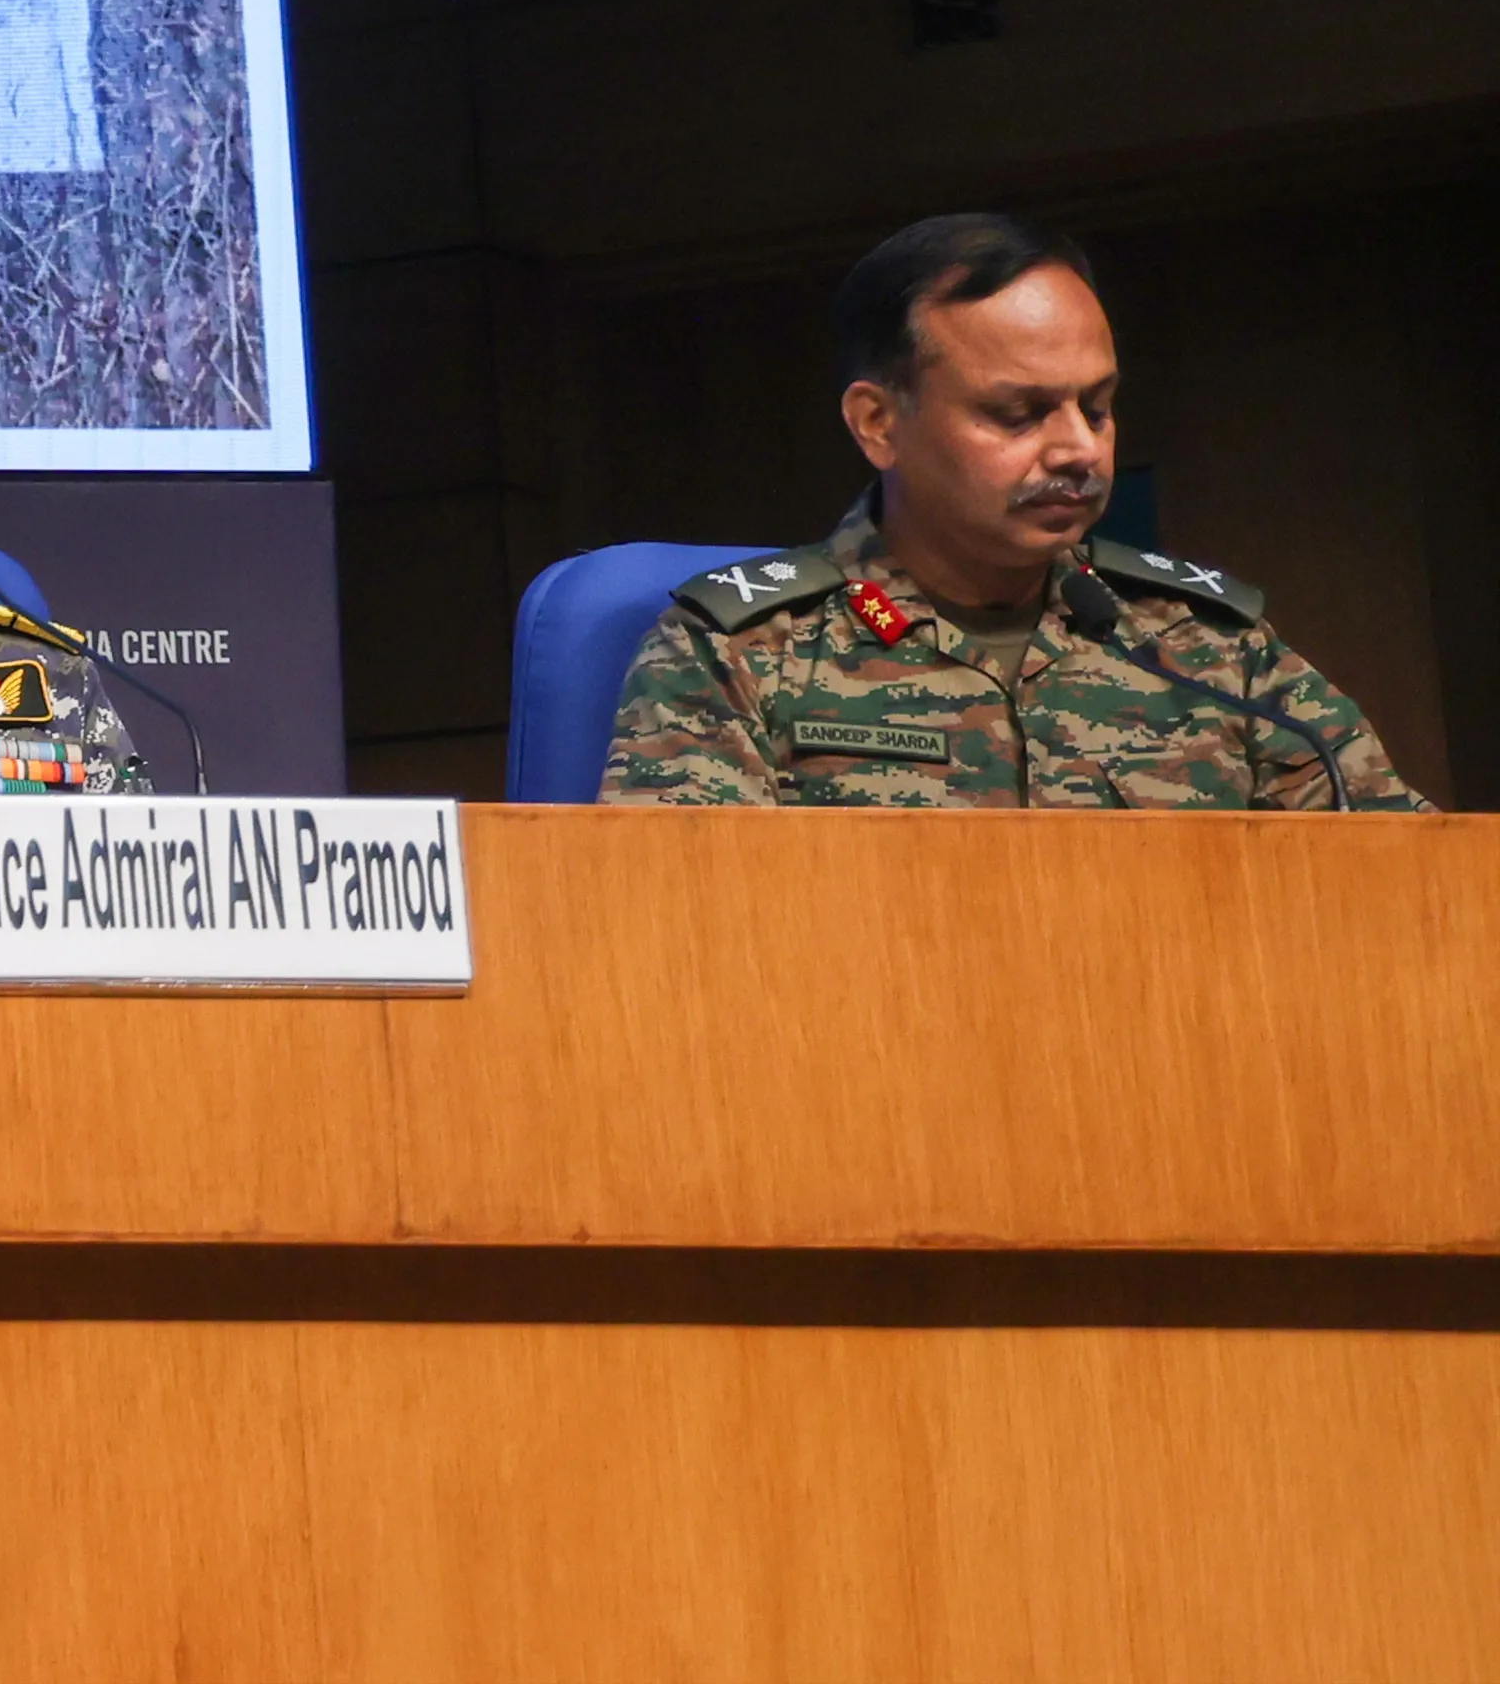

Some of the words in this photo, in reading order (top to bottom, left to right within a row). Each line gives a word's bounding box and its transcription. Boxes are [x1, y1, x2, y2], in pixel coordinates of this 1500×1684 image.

[122, 629, 231, 664] CENTRE
[800, 724, 872, 744] SANDEEP
[876, 728, 940, 752] SHARDA
[62, 808, 215, 930] Admiral
[229, 808, 287, 929] AN
[293, 809, 453, 932] Pramod
